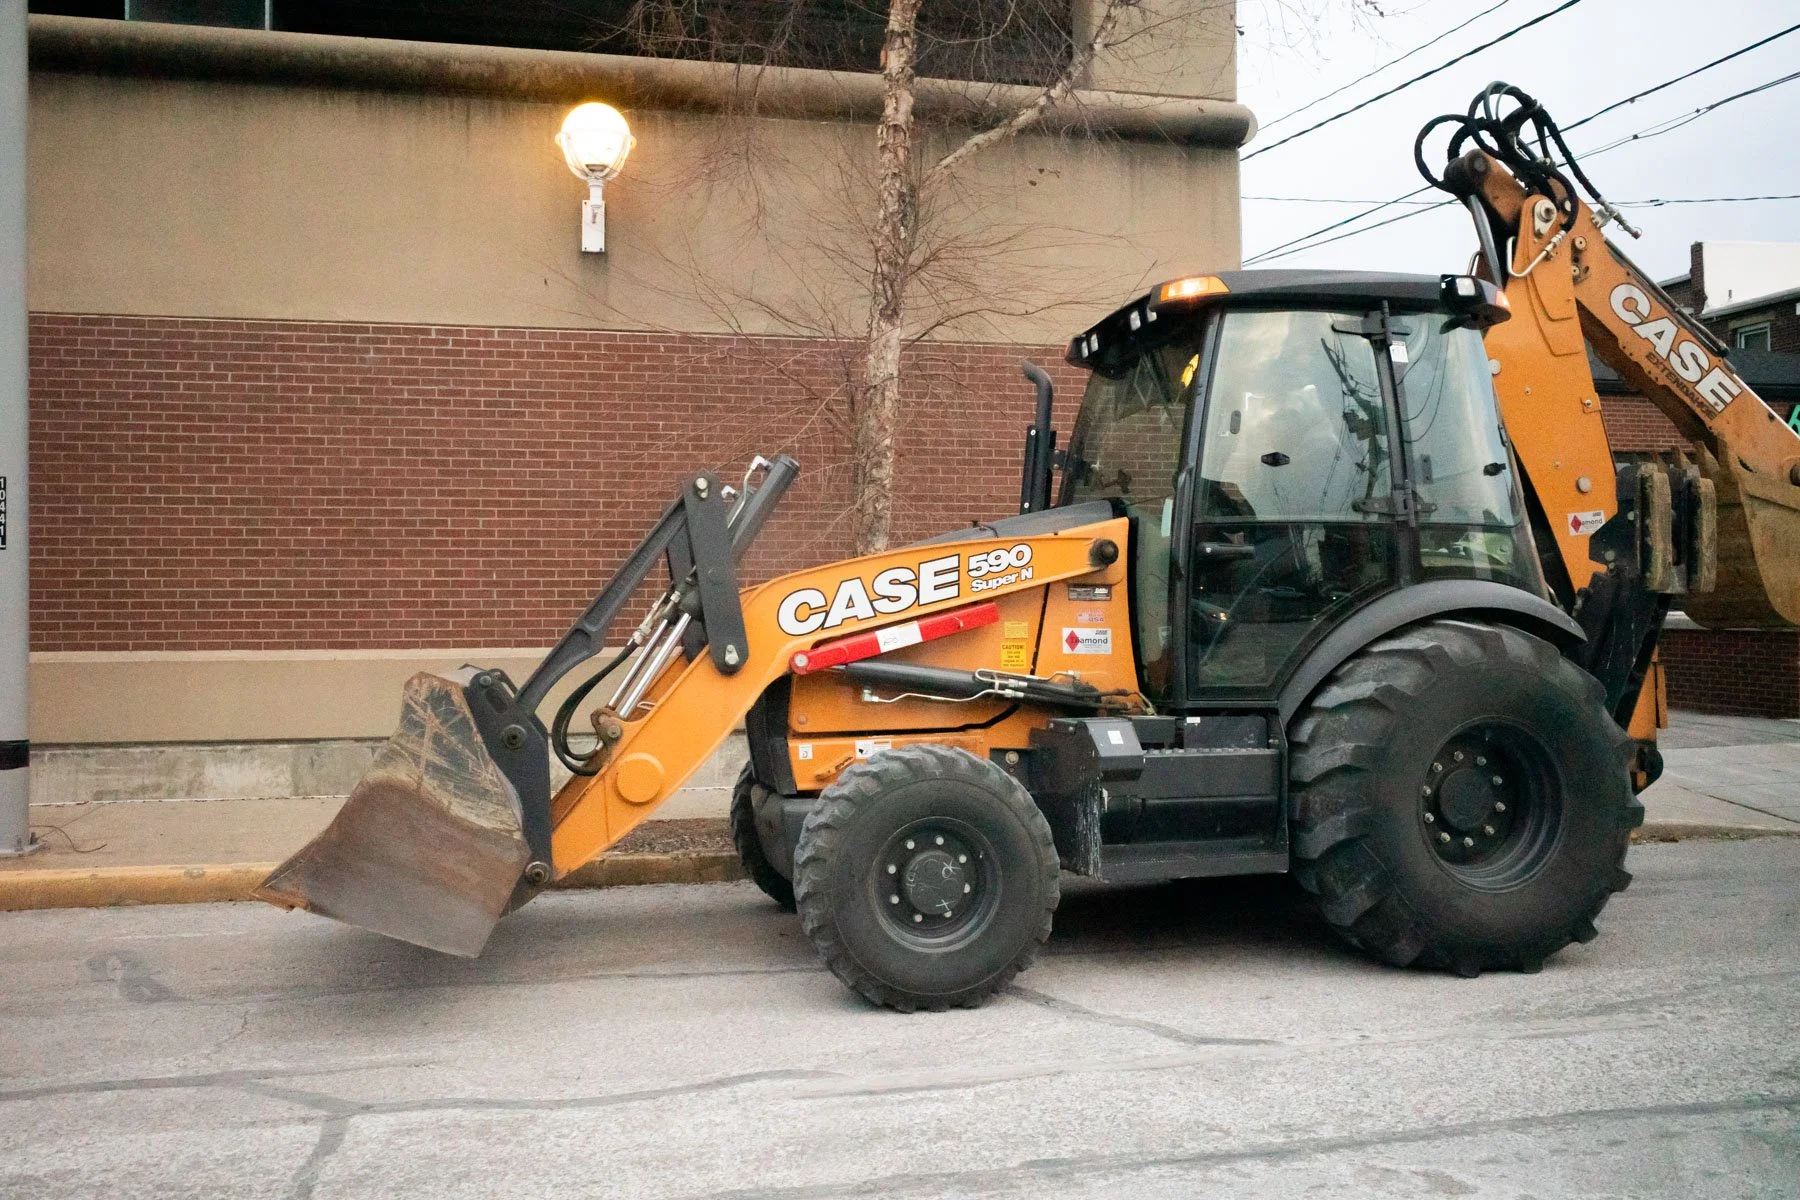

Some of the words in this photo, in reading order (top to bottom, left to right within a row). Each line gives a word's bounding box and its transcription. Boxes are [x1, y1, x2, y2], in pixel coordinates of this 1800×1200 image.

[1610, 283, 1742, 413] CASE
[1645, 352, 1717, 420] EXTENDAHOE
[777, 554, 960, 636] CASE
[967, 543, 1033, 578] 590
[971, 572, 1019, 592] Super
[1020, 566, 1033, 581] N
